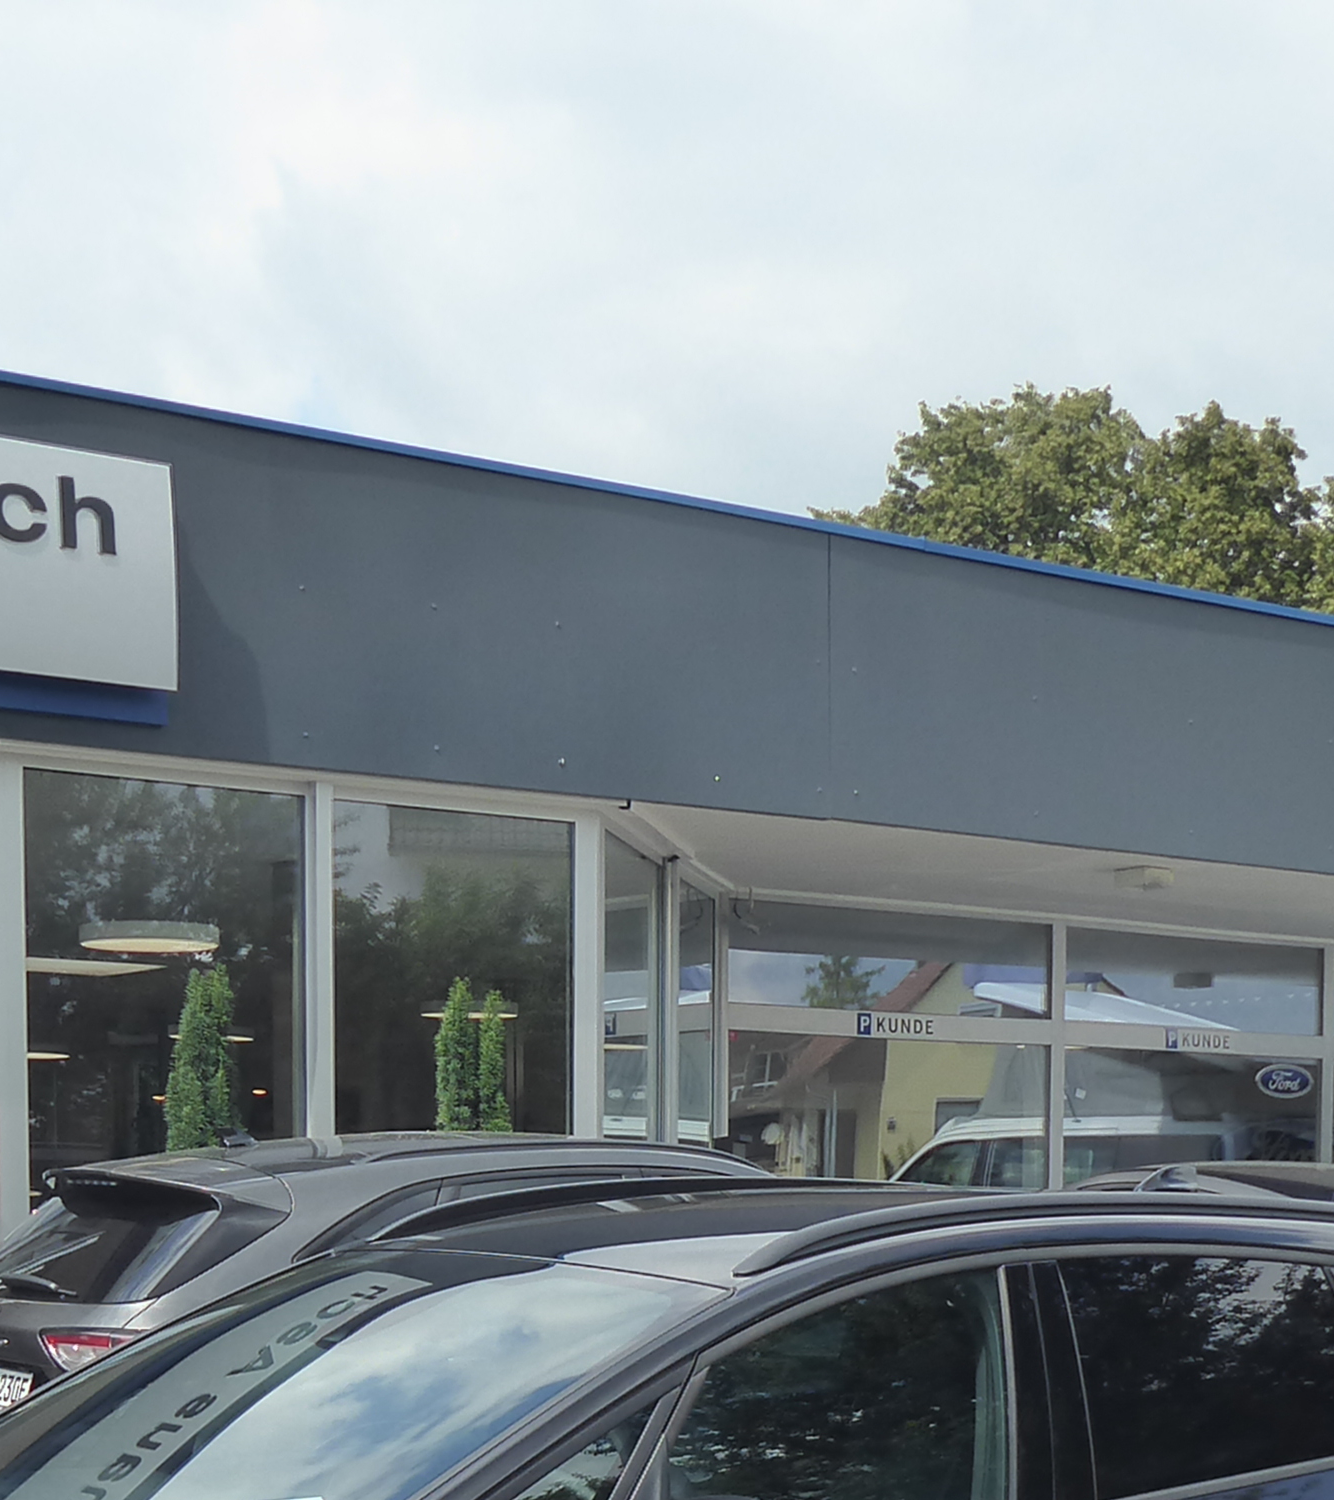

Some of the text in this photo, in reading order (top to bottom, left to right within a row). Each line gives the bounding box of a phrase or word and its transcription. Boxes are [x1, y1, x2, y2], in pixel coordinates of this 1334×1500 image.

[876, 1016, 934, 1035] KUNDE
[1182, 1033, 1230, 1049] KUNDE
[1269, 1070, 1301, 1091] Ford
